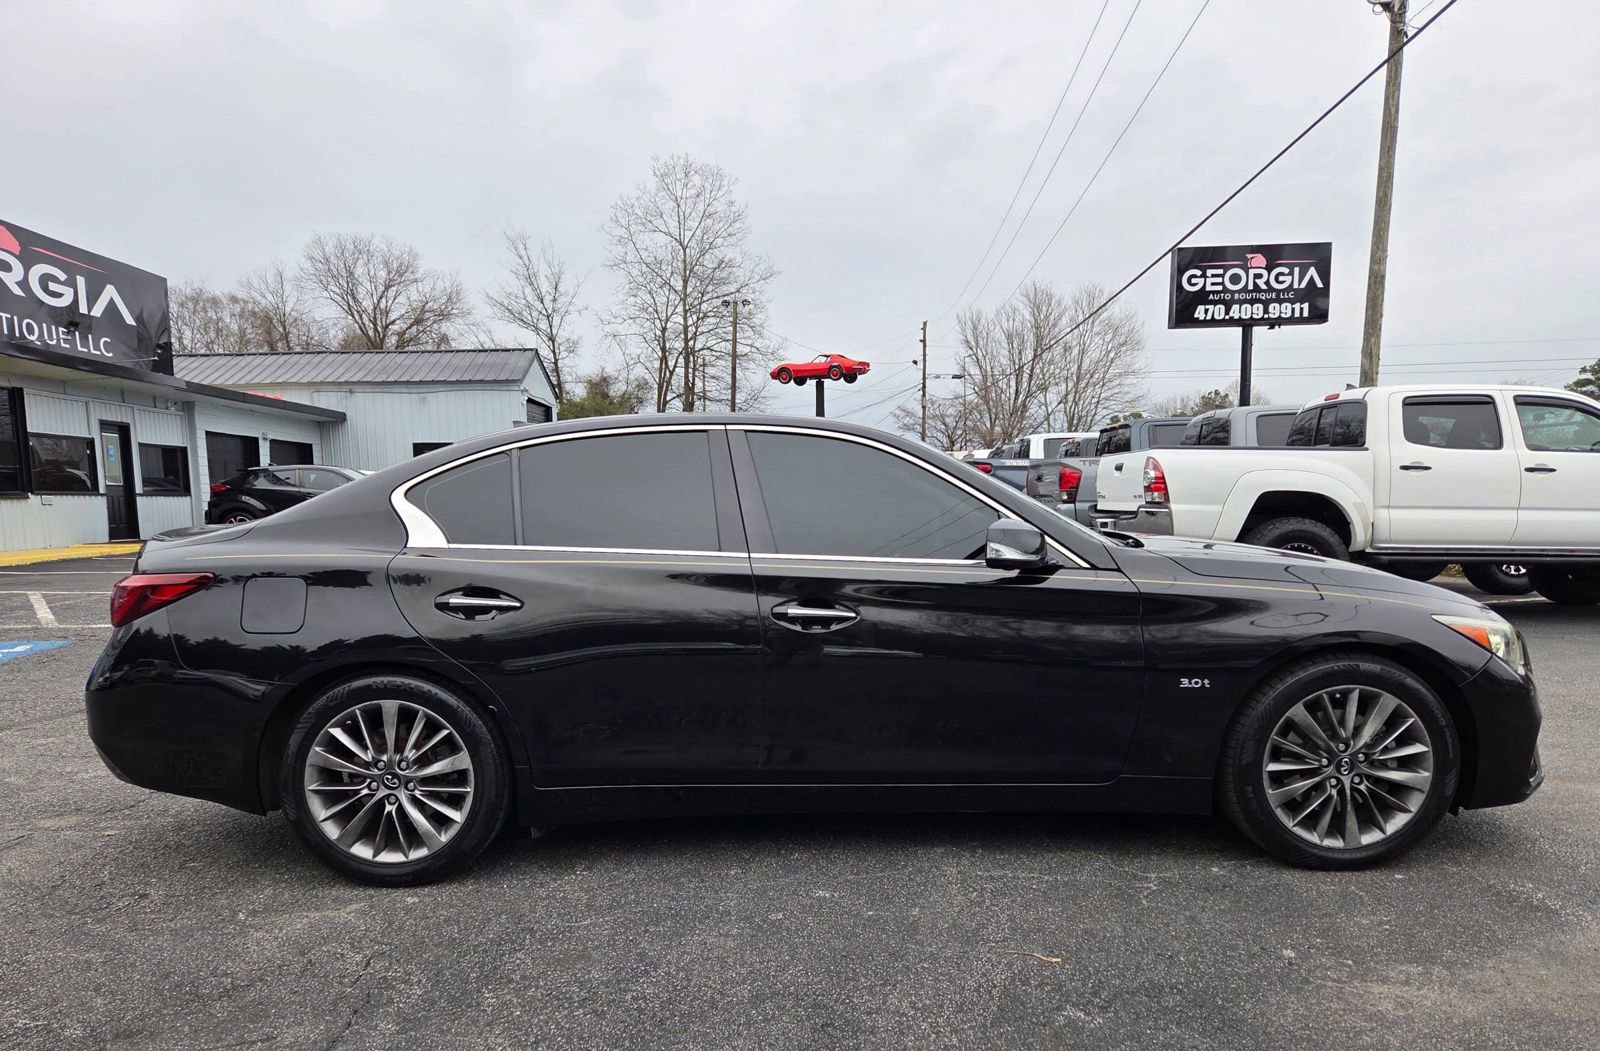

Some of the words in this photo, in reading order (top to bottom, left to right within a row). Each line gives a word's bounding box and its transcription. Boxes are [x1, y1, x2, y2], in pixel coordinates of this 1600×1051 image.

[1181, 266, 1324, 292] GEORGIA
[1234, 292, 1277, 300] BOUTIQUE
[1280, 291, 1295, 299] LLC
[1194, 302, 1309, 320] 470.409.9911
[75, 331, 113, 357] LLC
